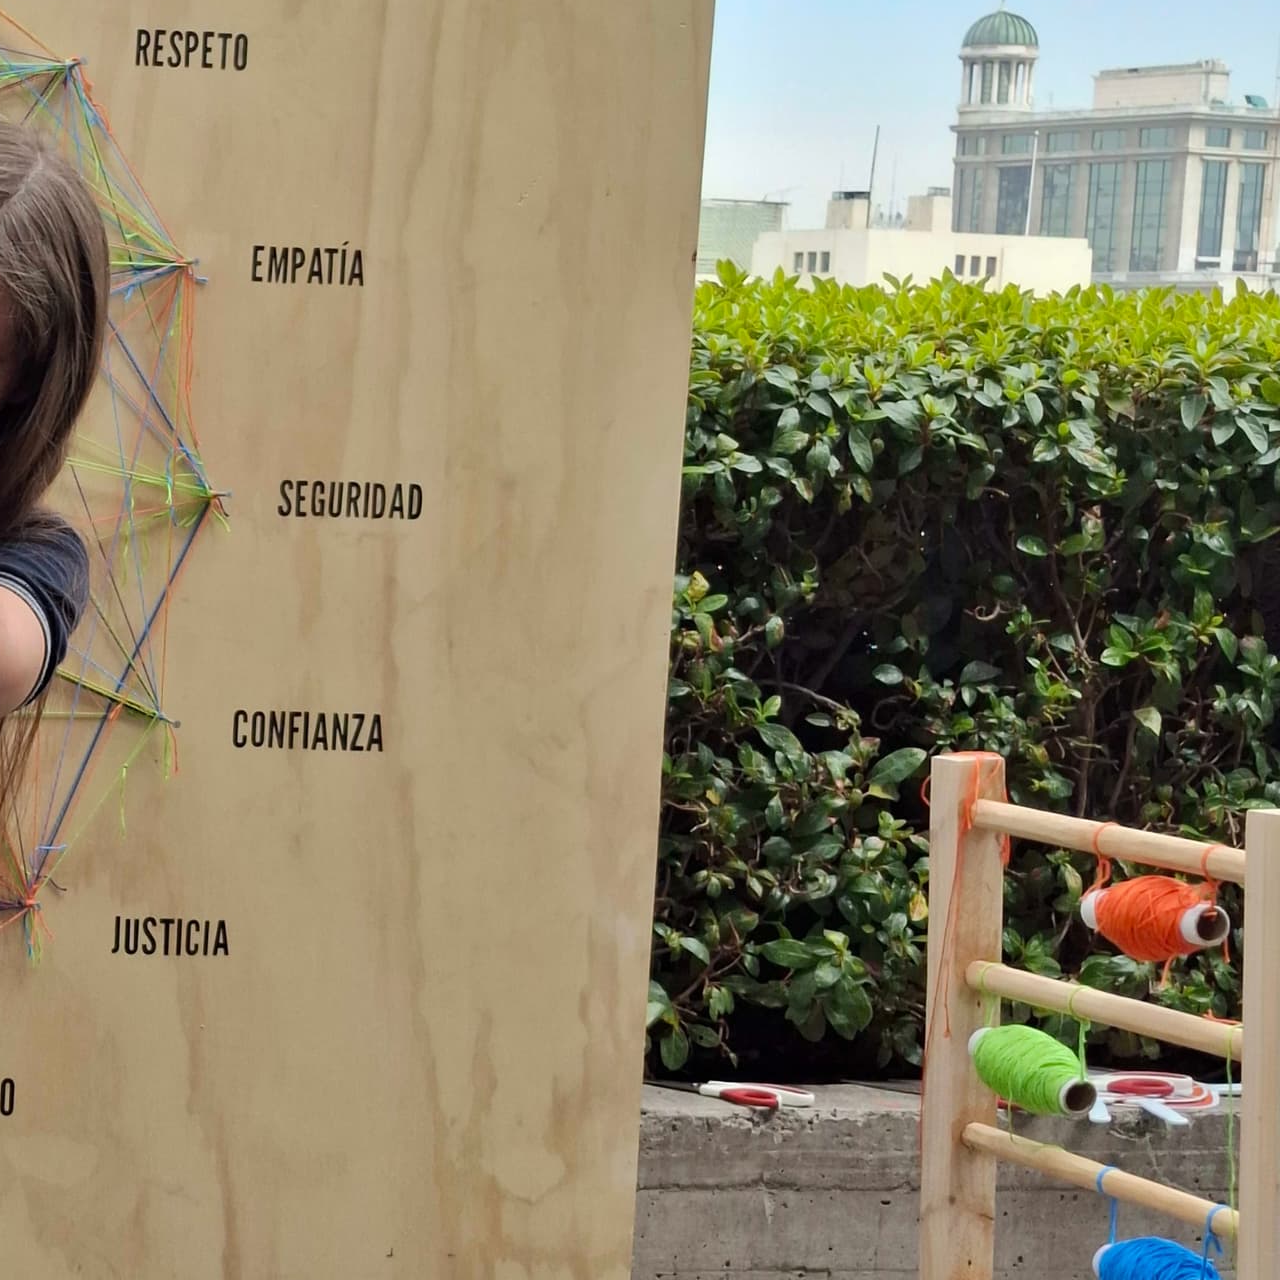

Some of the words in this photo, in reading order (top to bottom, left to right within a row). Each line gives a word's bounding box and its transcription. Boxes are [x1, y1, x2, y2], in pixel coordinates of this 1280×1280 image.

[135, 28, 249, 71] RESPETO
[250, 240, 365, 287] EMPATÍA
[277, 479, 423, 520] SEGURIDAD
[232, 709, 384, 753] CONFIANZA
[111, 915, 230, 957] JUSTICIA
